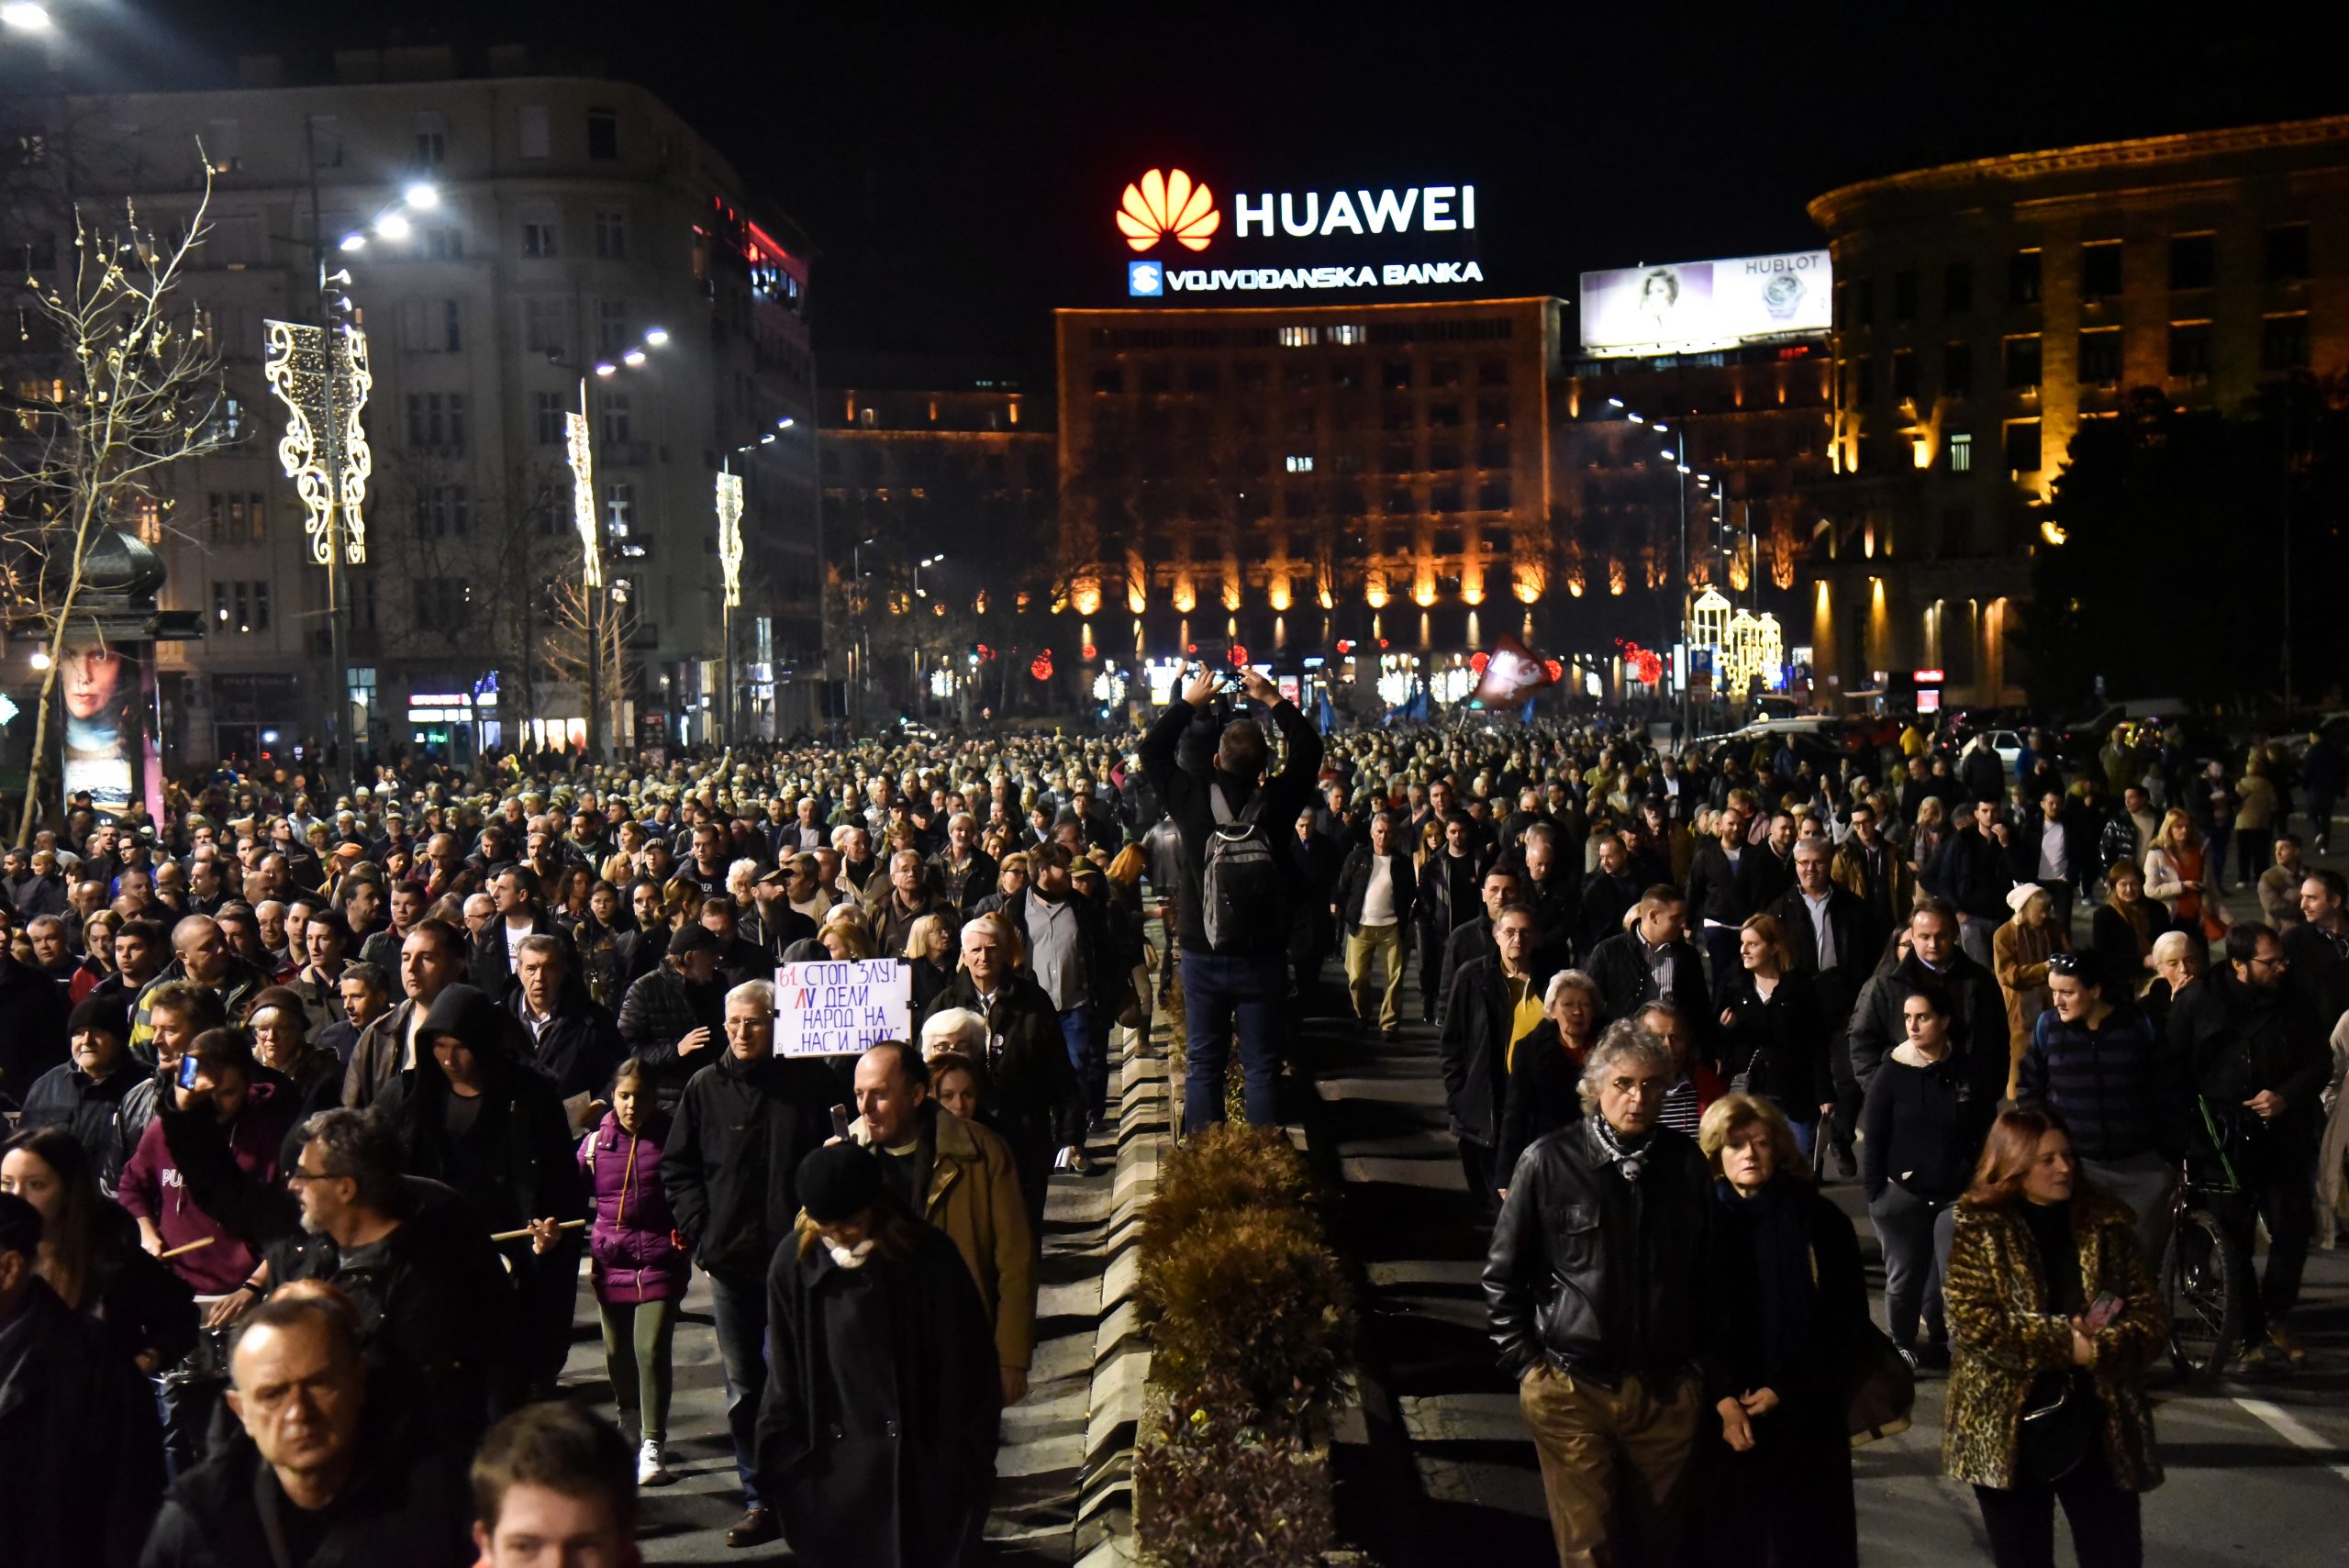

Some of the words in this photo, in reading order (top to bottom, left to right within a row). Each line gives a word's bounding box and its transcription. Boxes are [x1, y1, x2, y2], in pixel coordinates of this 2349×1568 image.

[1235, 185, 1475, 238] HUAWEI
[1745, 255, 1820, 274] HUBLOT
[1165, 266, 1378, 291] VOJVOĐANSKA
[1383, 261, 1484, 285] BANKA
[805, 964, 848, 986] СТОП
[856, 961, 896, 984] ЗЛУ!
[825, 985, 869, 1007] ДЕЛИ
[803, 1008, 854, 1029] НАРОД
[864, 1006, 885, 1027] НА
[838, 1030, 849, 1051] И
[161, 1168, 187, 1187] PU
